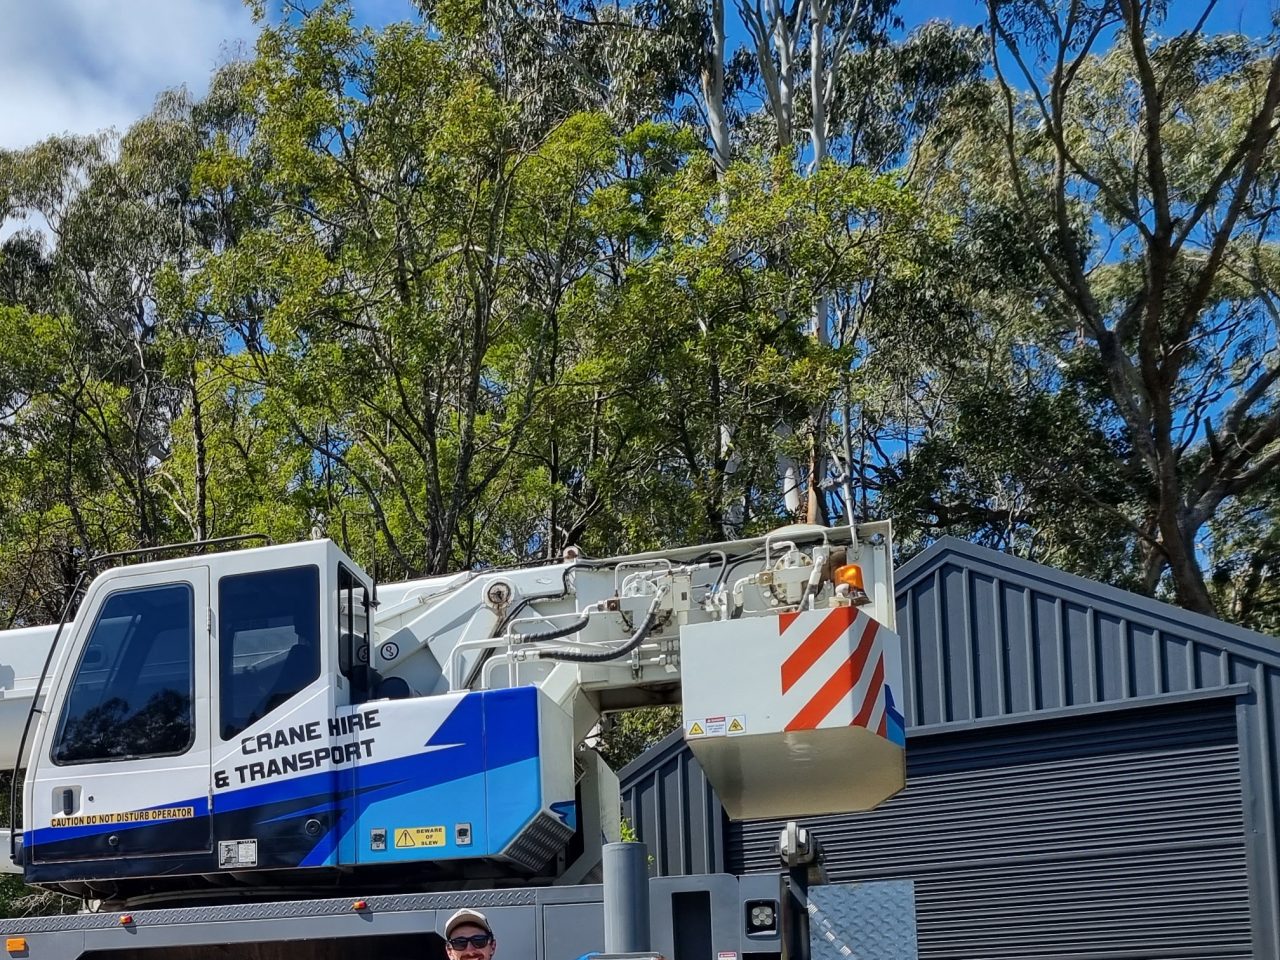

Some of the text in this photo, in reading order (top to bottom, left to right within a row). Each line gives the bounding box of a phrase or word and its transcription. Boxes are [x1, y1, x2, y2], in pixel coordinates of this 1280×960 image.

[241, 709, 381, 755] CRANE HIRE
[214, 738, 375, 788] & TRANSPORT
[51, 808, 192, 827] CAUTION DO NOT DISTURB OPERATOR
